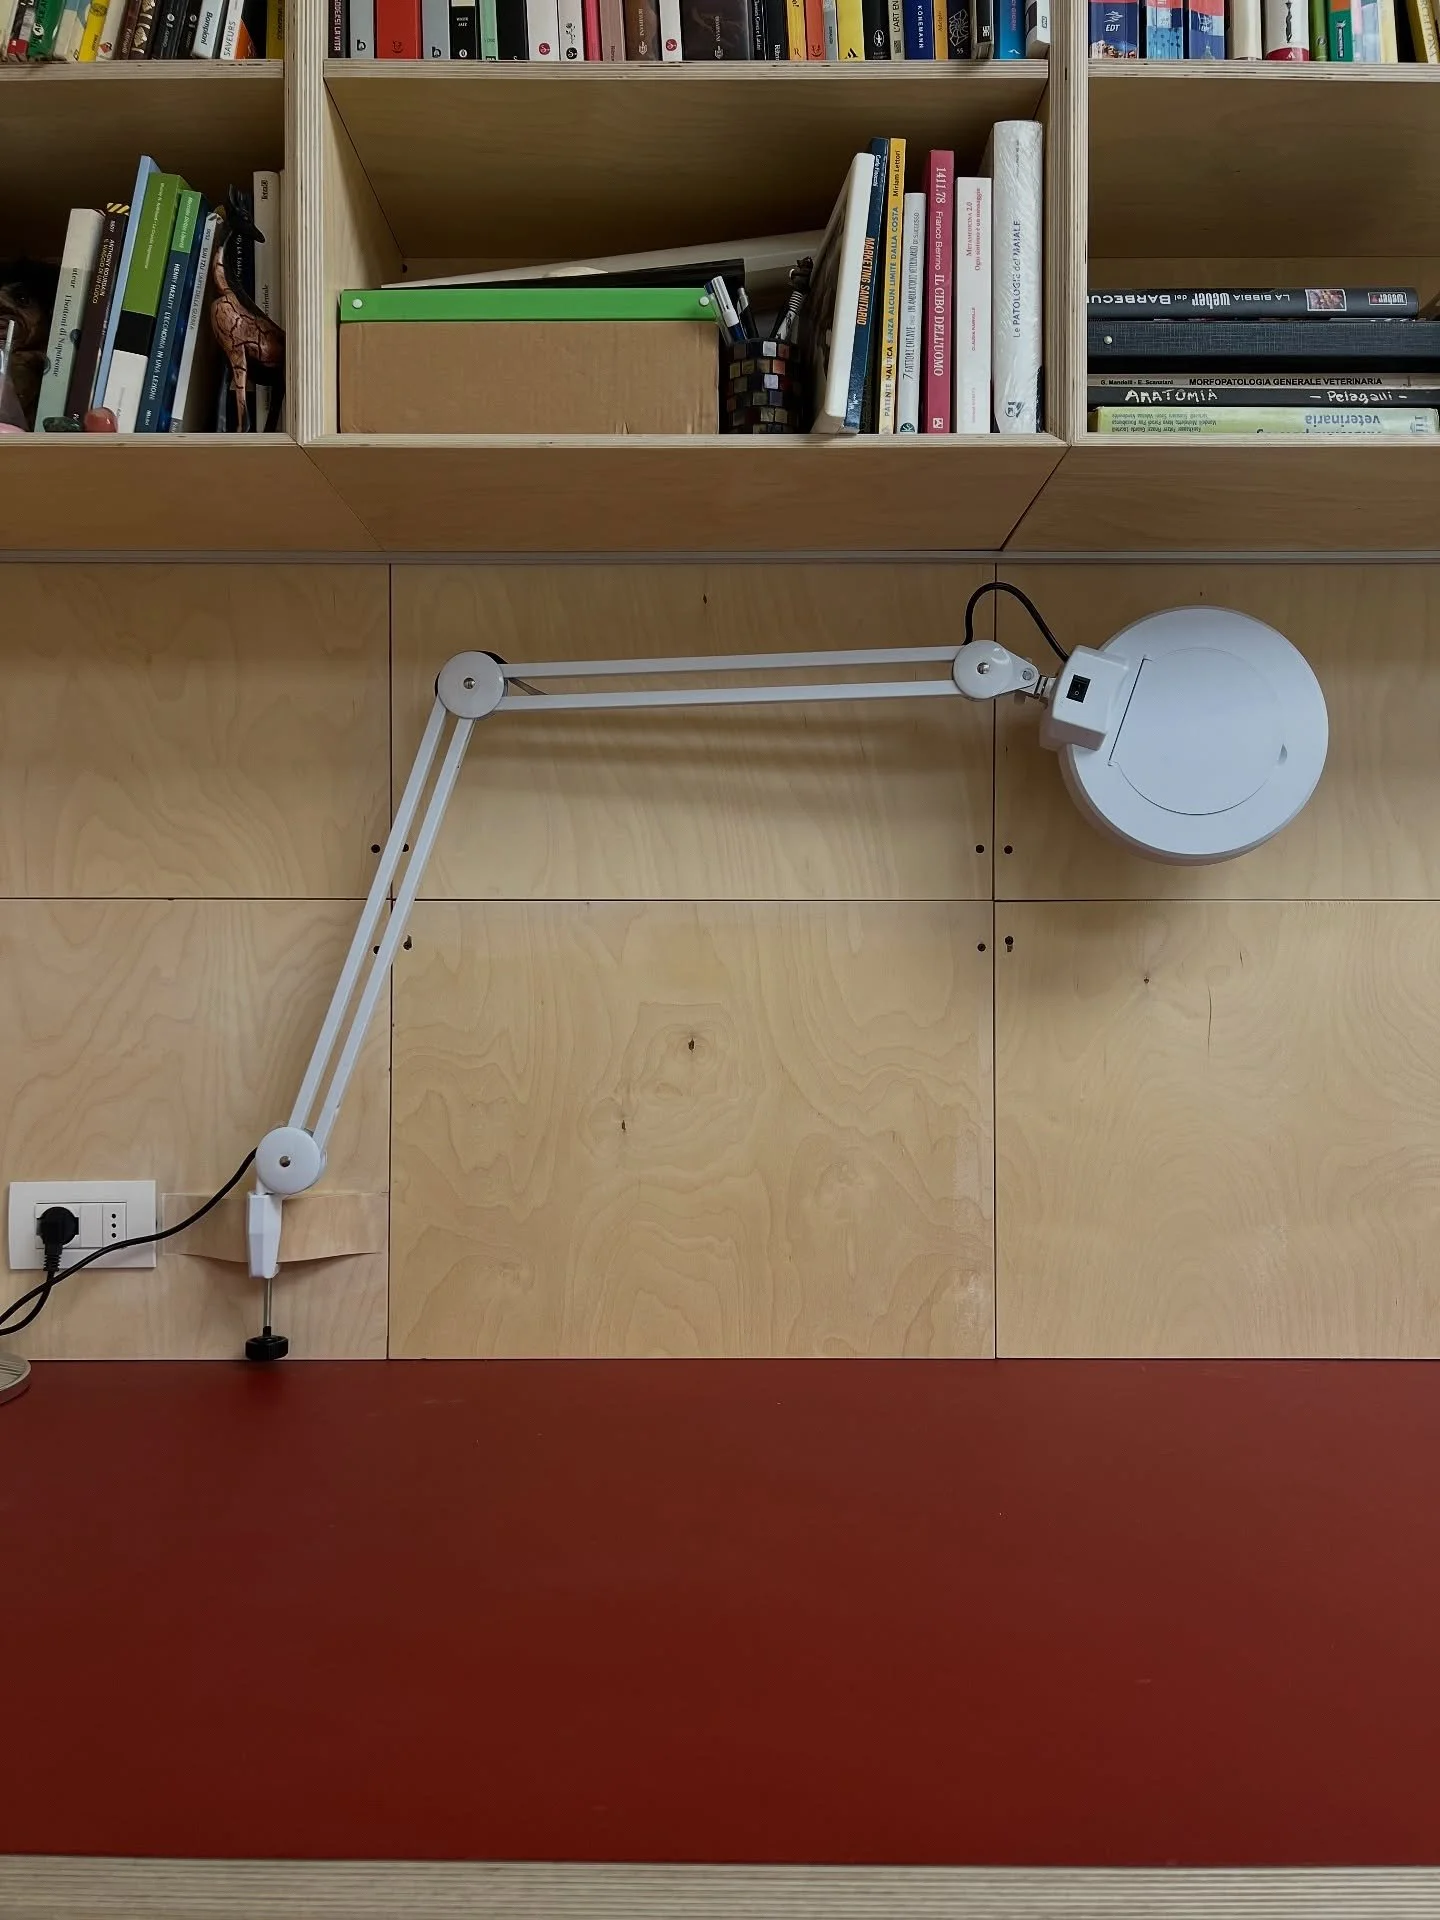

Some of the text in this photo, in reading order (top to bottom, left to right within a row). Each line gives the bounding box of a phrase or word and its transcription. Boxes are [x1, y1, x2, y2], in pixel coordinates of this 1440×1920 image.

[201, 11, 214, 46] Bompiani
[334, 26, 341, 35] LA
[893, 12, 901, 32] L'ART
[1106, 24, 1120, 32] EDT
[223, 20, 236, 56] SAVEURS
[892, 150, 901, 197] Miriam Lettori
[936, 166, 946, 204] 1411.78
[891, 206, 899, 232] COSTA
[1012, 220, 1021, 257] MAIALE
[106, 239, 114, 268] ANTHONY
[909, 245, 918, 274] VETERINARIO
[934, 241, 943, 270] Berrino
[99, 268, 109, 297] BOURDAIN
[172, 263, 180, 283] HENRY
[856, 237, 876, 326] MARKETING SANITARIO
[935, 274, 944, 286] IL
[167, 284, 176, 310] HAZLITT
[192, 290, 200, 306] DELLA
[888, 288, 896, 315] ALCUN
[908, 274, 917, 305] AMBULATORIO
[934, 287, 944, 314] CIBO
[62, 297, 71, 326] bottoni
[188, 308, 196, 330] GUERRA
[158, 311, 170, 350] L'ECONOMIA
[886, 318, 894, 344] SENZA
[906, 326, 916, 348] CHIAVE
[1012, 328, 1020, 338] Le
[52, 338, 64, 377] Napoleone
[934, 316, 944, 376] DELL'UOMO
[885, 346, 894, 381] NAUTICA
[904, 348, 915, 372] FATTORI
[150, 375, 159, 401] LEZIONE
[884, 384, 892, 416] PATENTE
[1124, 389, 1218, 403] ANATOMIA
[1327, 391, 1393, 404] Pelagalli
[1305, 415, 1381, 426] veterinaria
